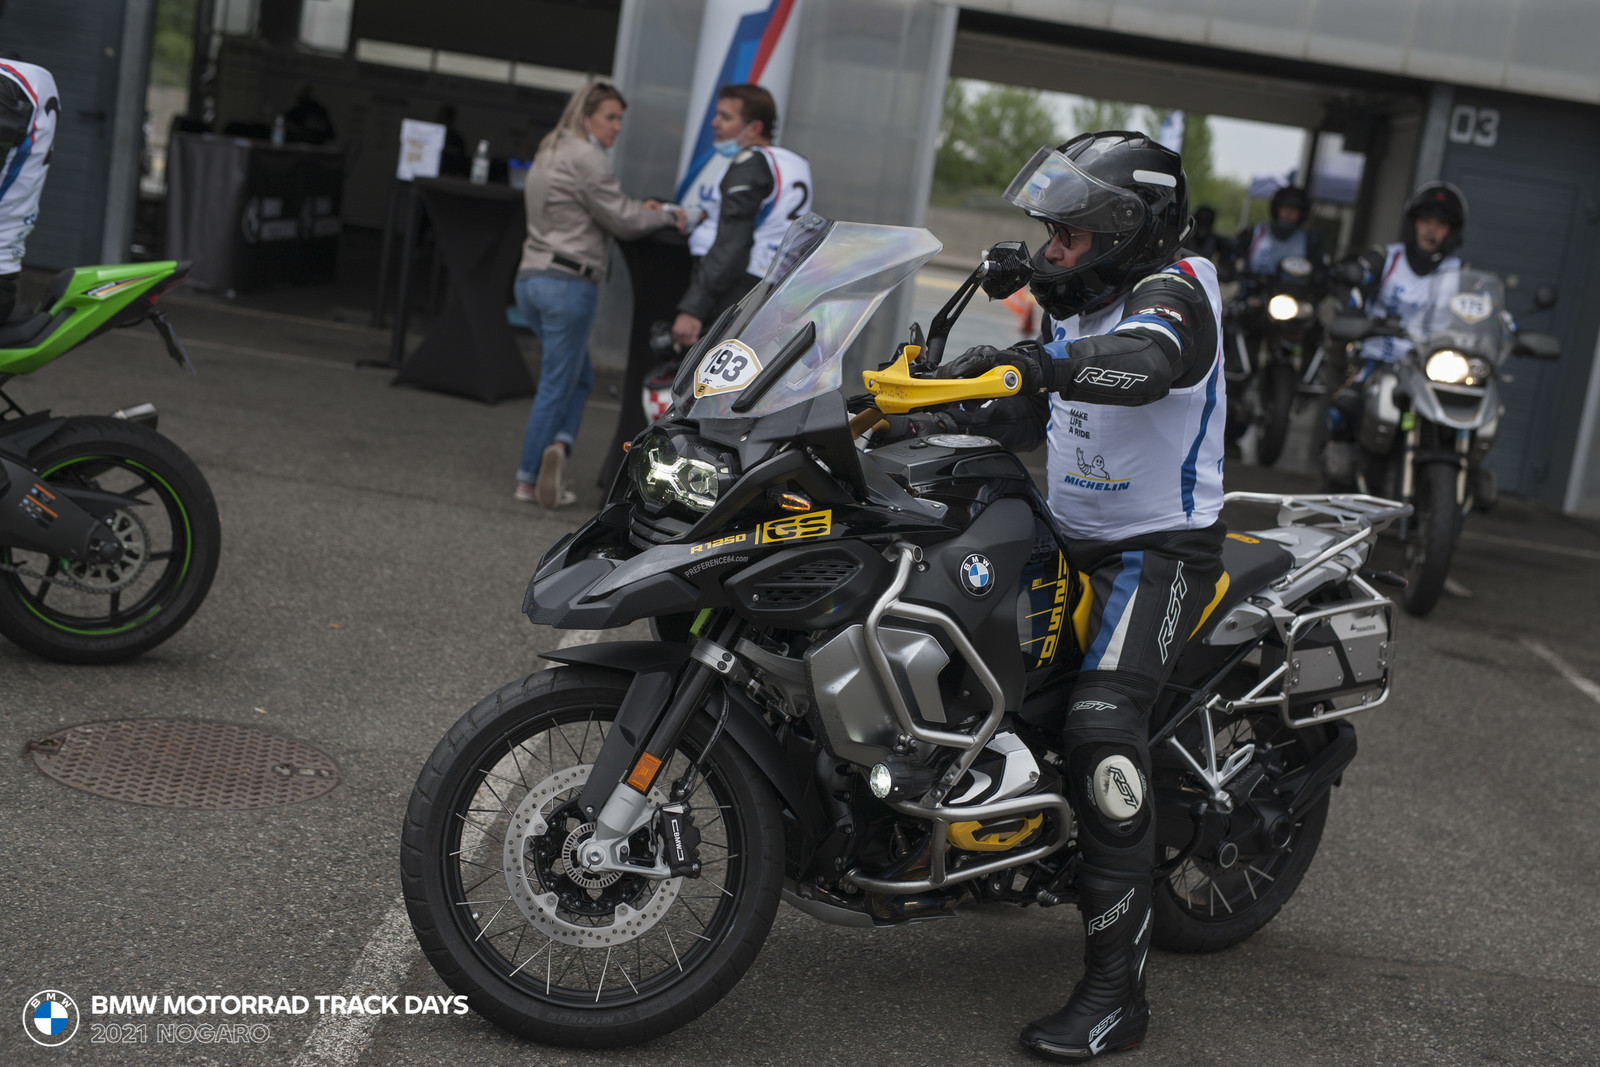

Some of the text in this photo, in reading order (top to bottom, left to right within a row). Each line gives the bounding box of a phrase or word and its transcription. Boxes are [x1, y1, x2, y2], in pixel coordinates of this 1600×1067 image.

[1449, 105, 1499, 147] 03
[787, 181, 808, 220] 2
[704, 349, 749, 382] 193
[1074, 366, 1149, 390] RST
[1069, 417, 1082, 428] LIFE
[1070, 408, 1088, 421] MAKE
[1068, 426, 1091, 439] A RIDE
[1064, 475, 1131, 491] MICHELIN
[765, 513, 829, 541] GS
[963, 556, 990, 571] BMW
[1158, 560, 1188, 665] RST
[1107, 766, 1139, 809] RST
[1088, 887, 1135, 936] RST
[547, 1011, 615, 1024] MICHELIN
[1088, 1007, 1123, 1043] RST
